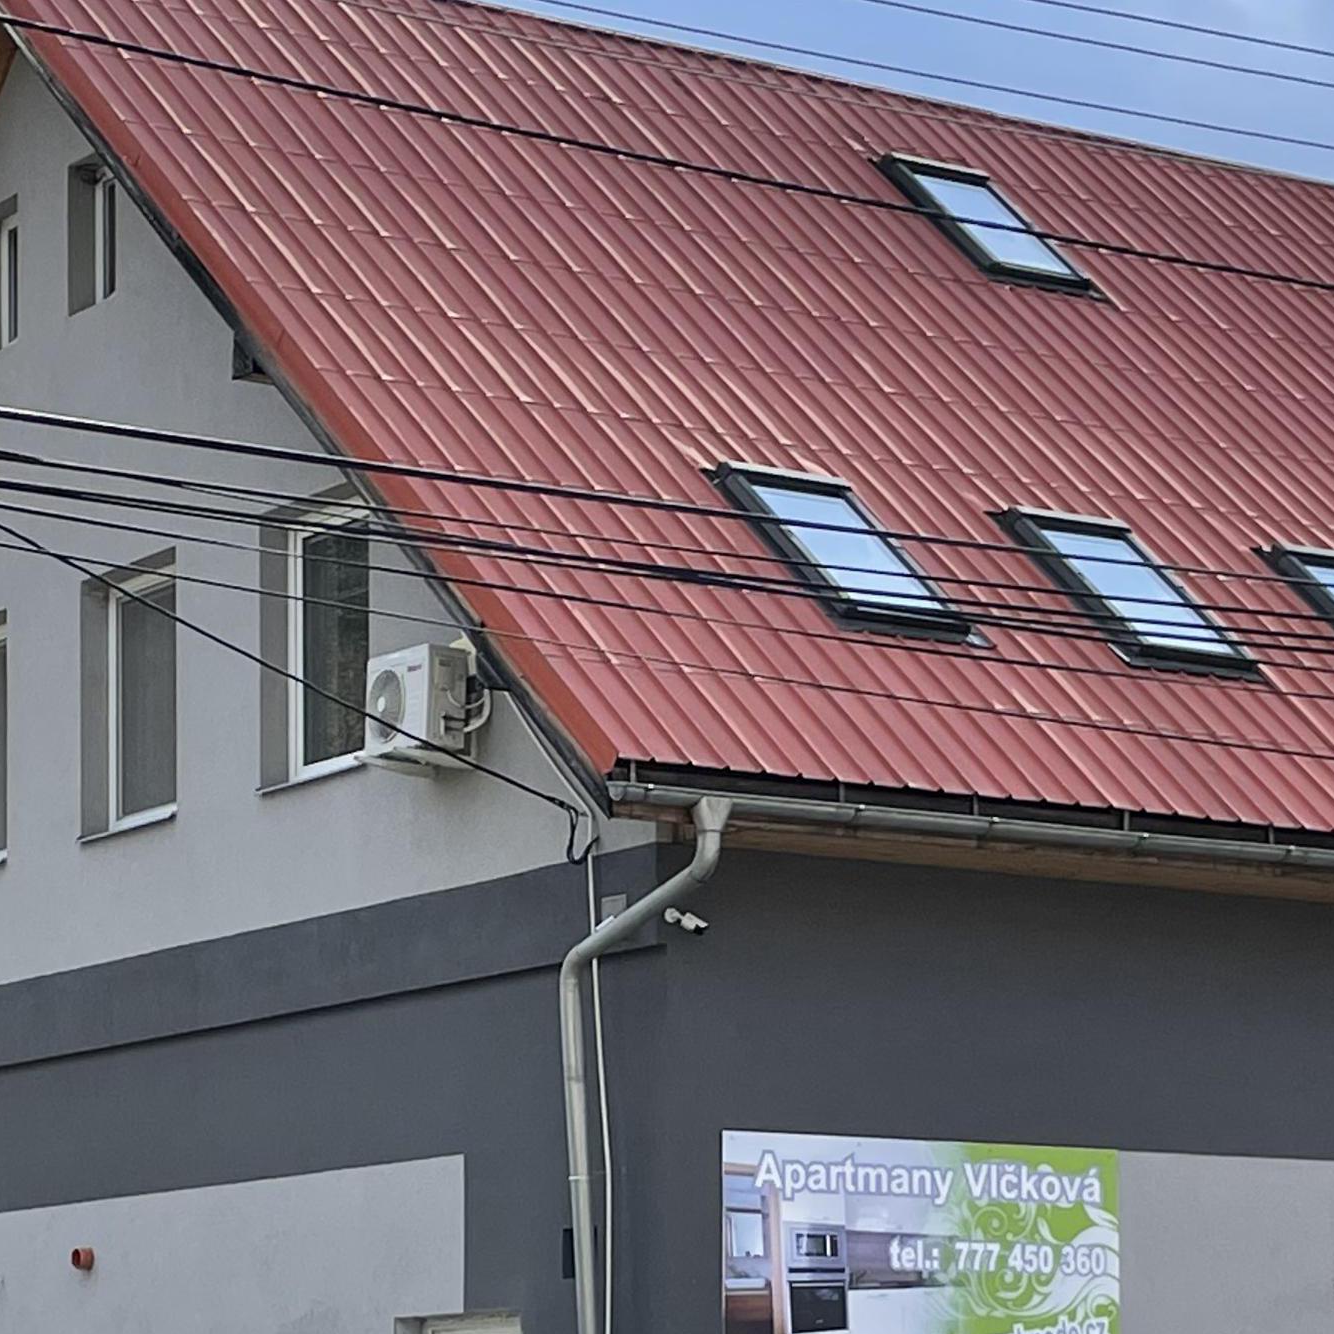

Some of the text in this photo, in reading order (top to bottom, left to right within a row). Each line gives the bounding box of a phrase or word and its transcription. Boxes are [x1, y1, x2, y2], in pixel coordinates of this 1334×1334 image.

[755, 1150, 1101, 1204] Apartmany Vlčková
[889, 1240, 1104, 1275] tel.: 777 450 360
